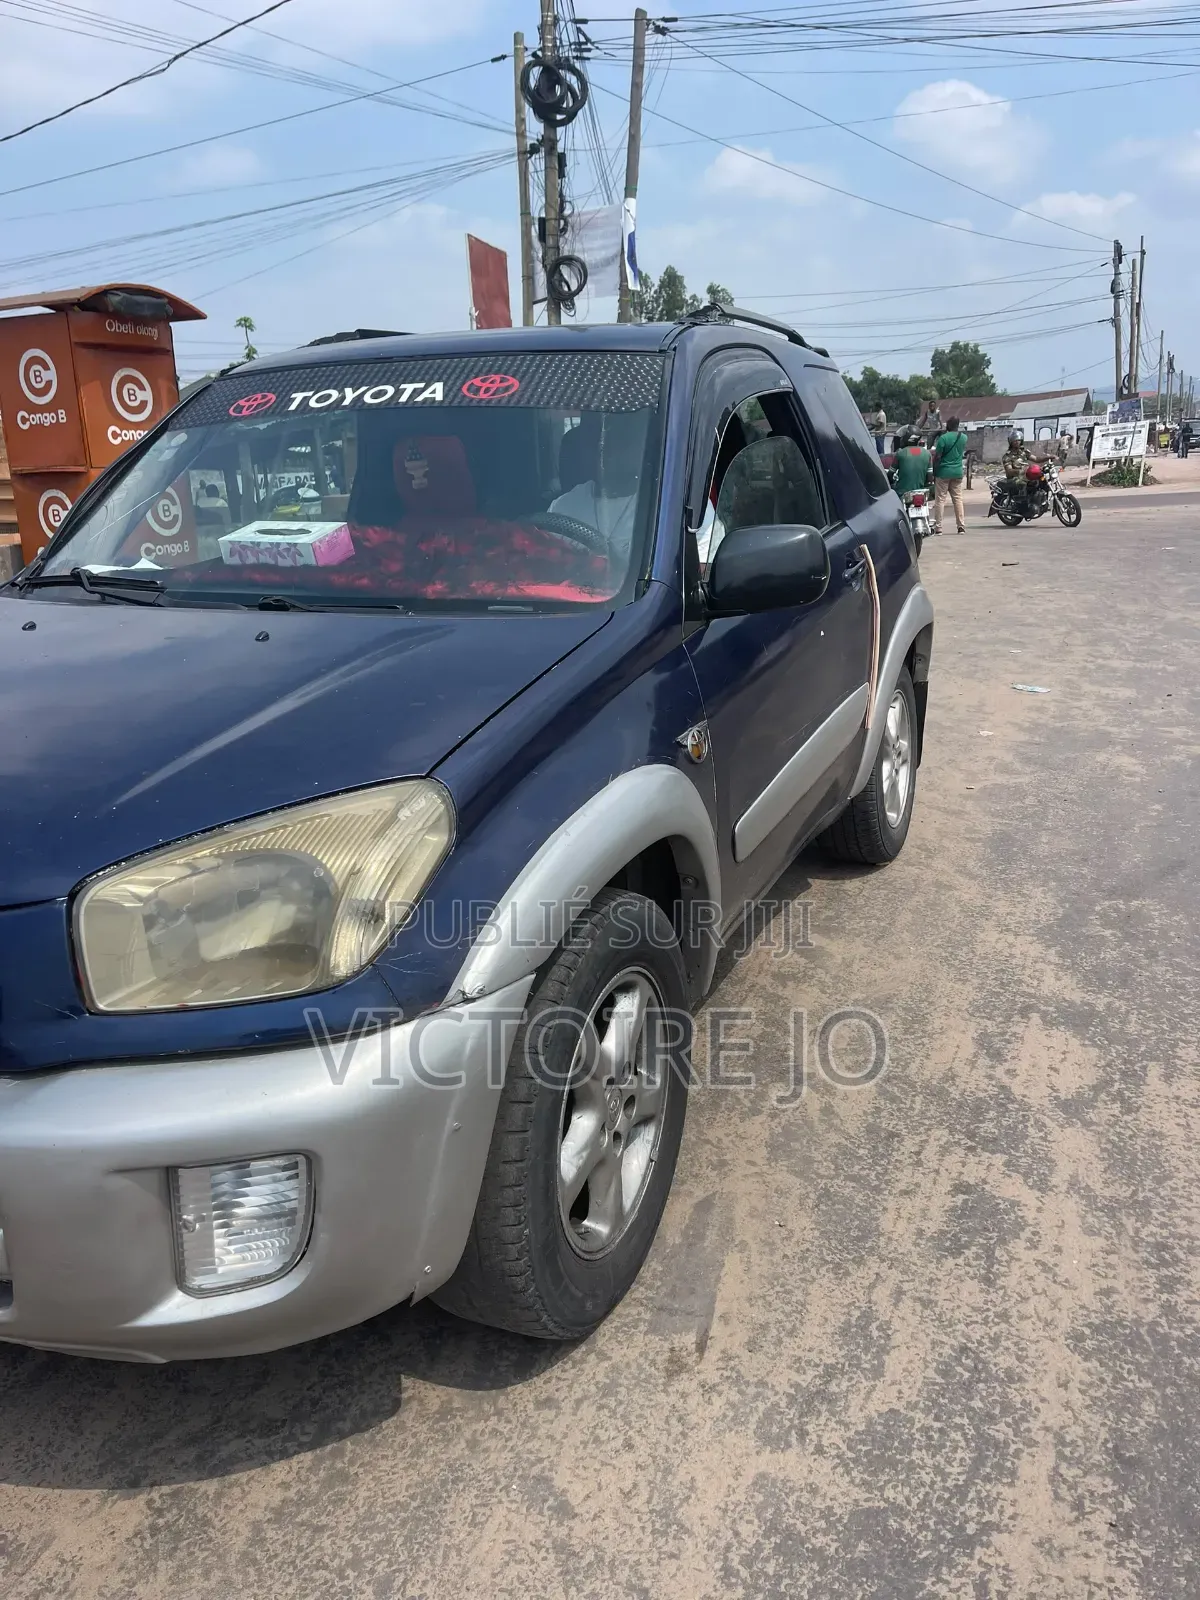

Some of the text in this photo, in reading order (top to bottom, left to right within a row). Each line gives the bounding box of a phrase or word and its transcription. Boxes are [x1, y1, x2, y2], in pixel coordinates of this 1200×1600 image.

[105, 319, 135, 334] Obeti
[287, 381, 444, 411] TOYOTA
[17, 409, 67, 430] Congo B
[140, 540, 190, 560] Congo B
